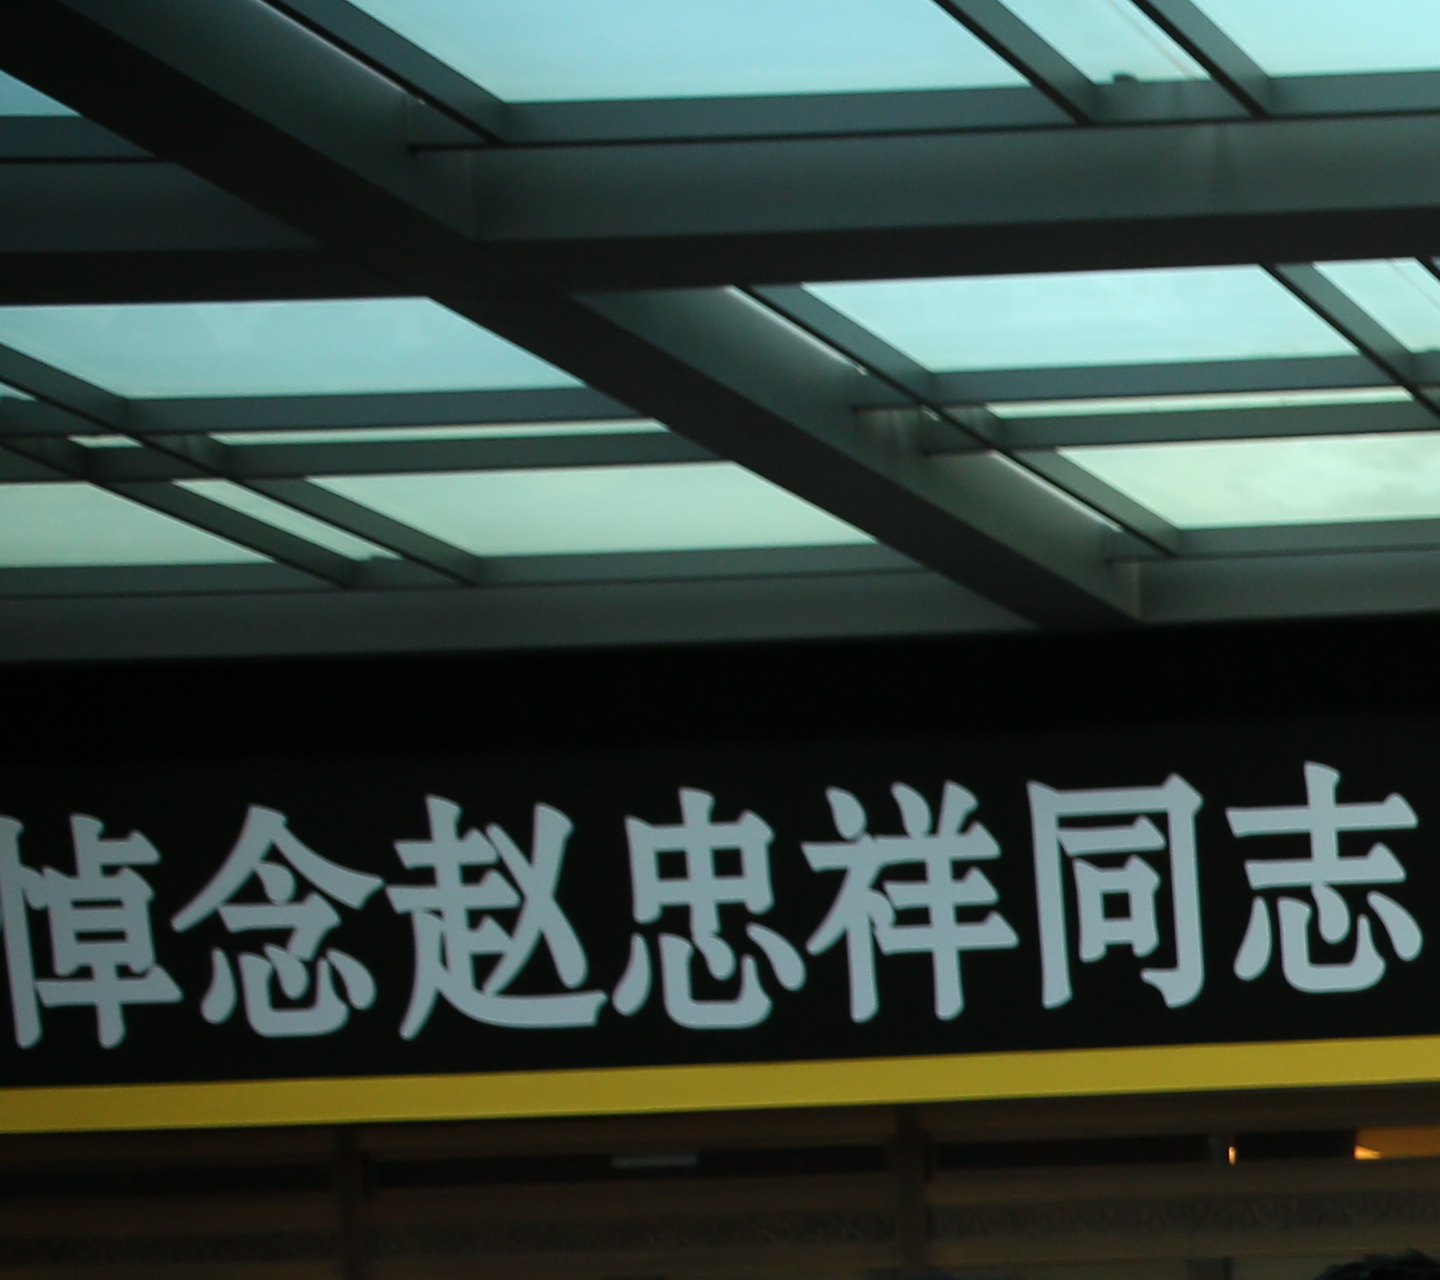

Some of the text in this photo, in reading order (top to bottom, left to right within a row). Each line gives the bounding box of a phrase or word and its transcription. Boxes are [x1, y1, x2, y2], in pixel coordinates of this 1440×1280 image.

[0, 761, 1423, 1048] 悼念赵忠祥同志
